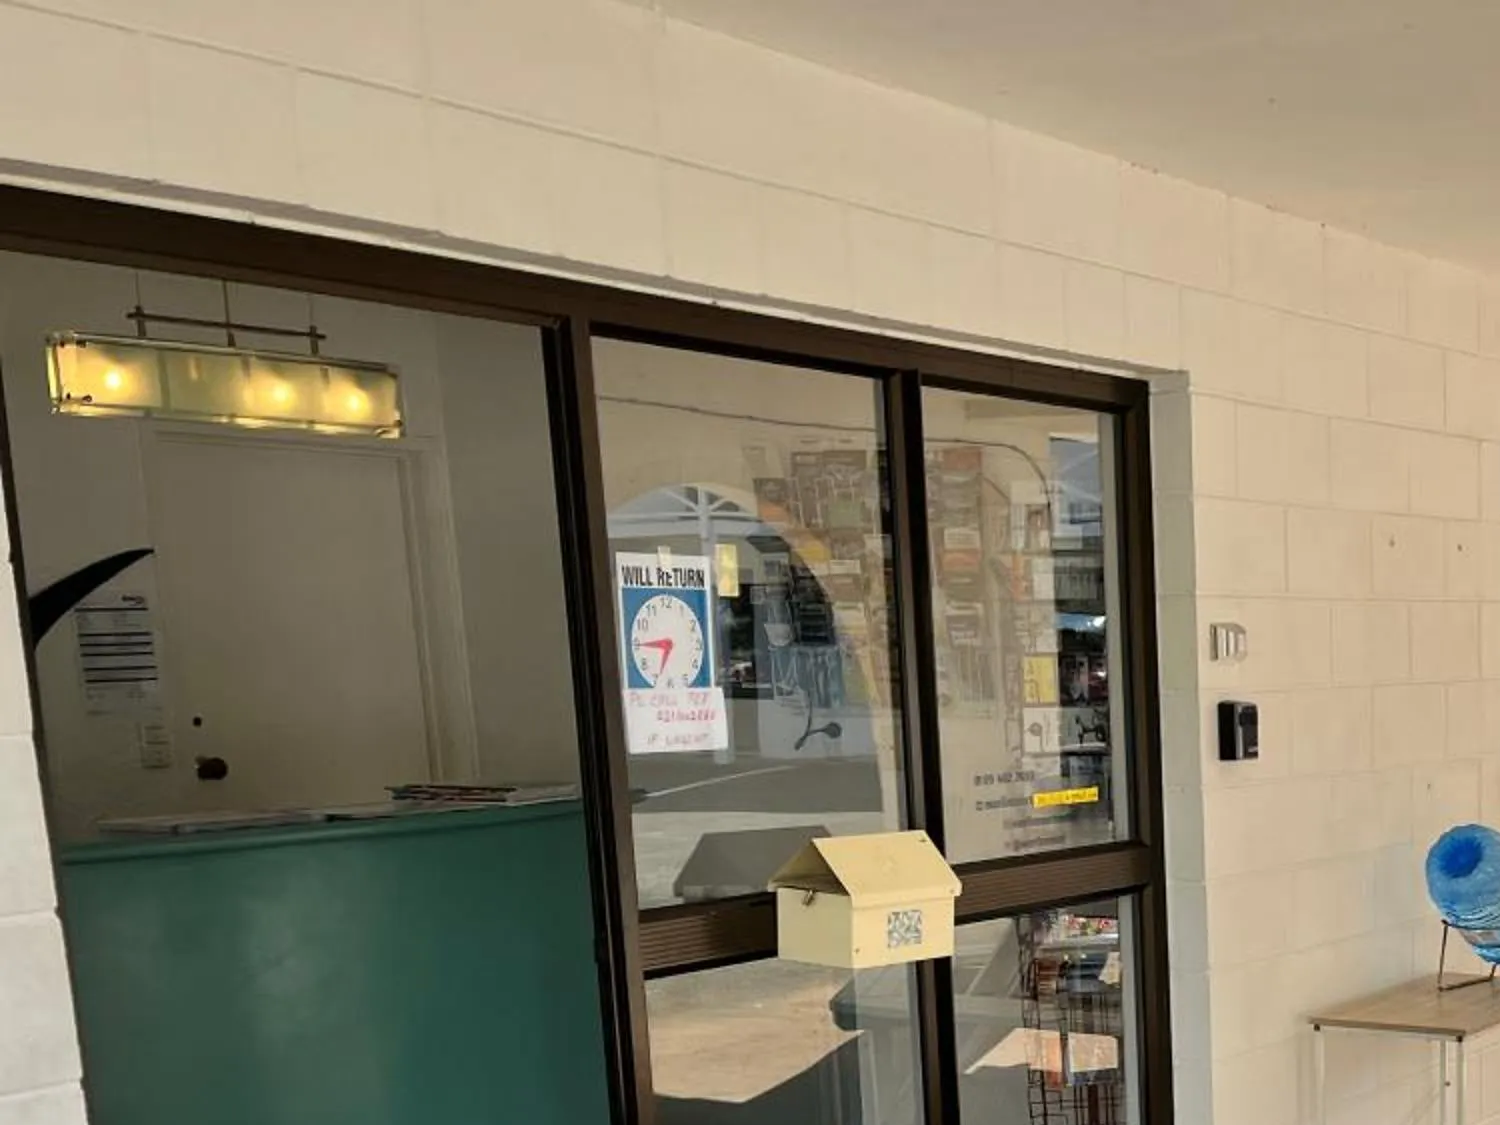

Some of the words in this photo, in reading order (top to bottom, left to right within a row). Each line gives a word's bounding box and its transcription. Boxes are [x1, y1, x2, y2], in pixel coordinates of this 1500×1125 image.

[621, 564, 653, 586] WILL
[656, 567, 705, 588] RETURN
[660, 597, 673, 609] 12
[645, 604, 657, 617] 11
[637, 618, 649, 631] 10
[689, 619, 697, 632] 2
[641, 657, 648, 671] 8
